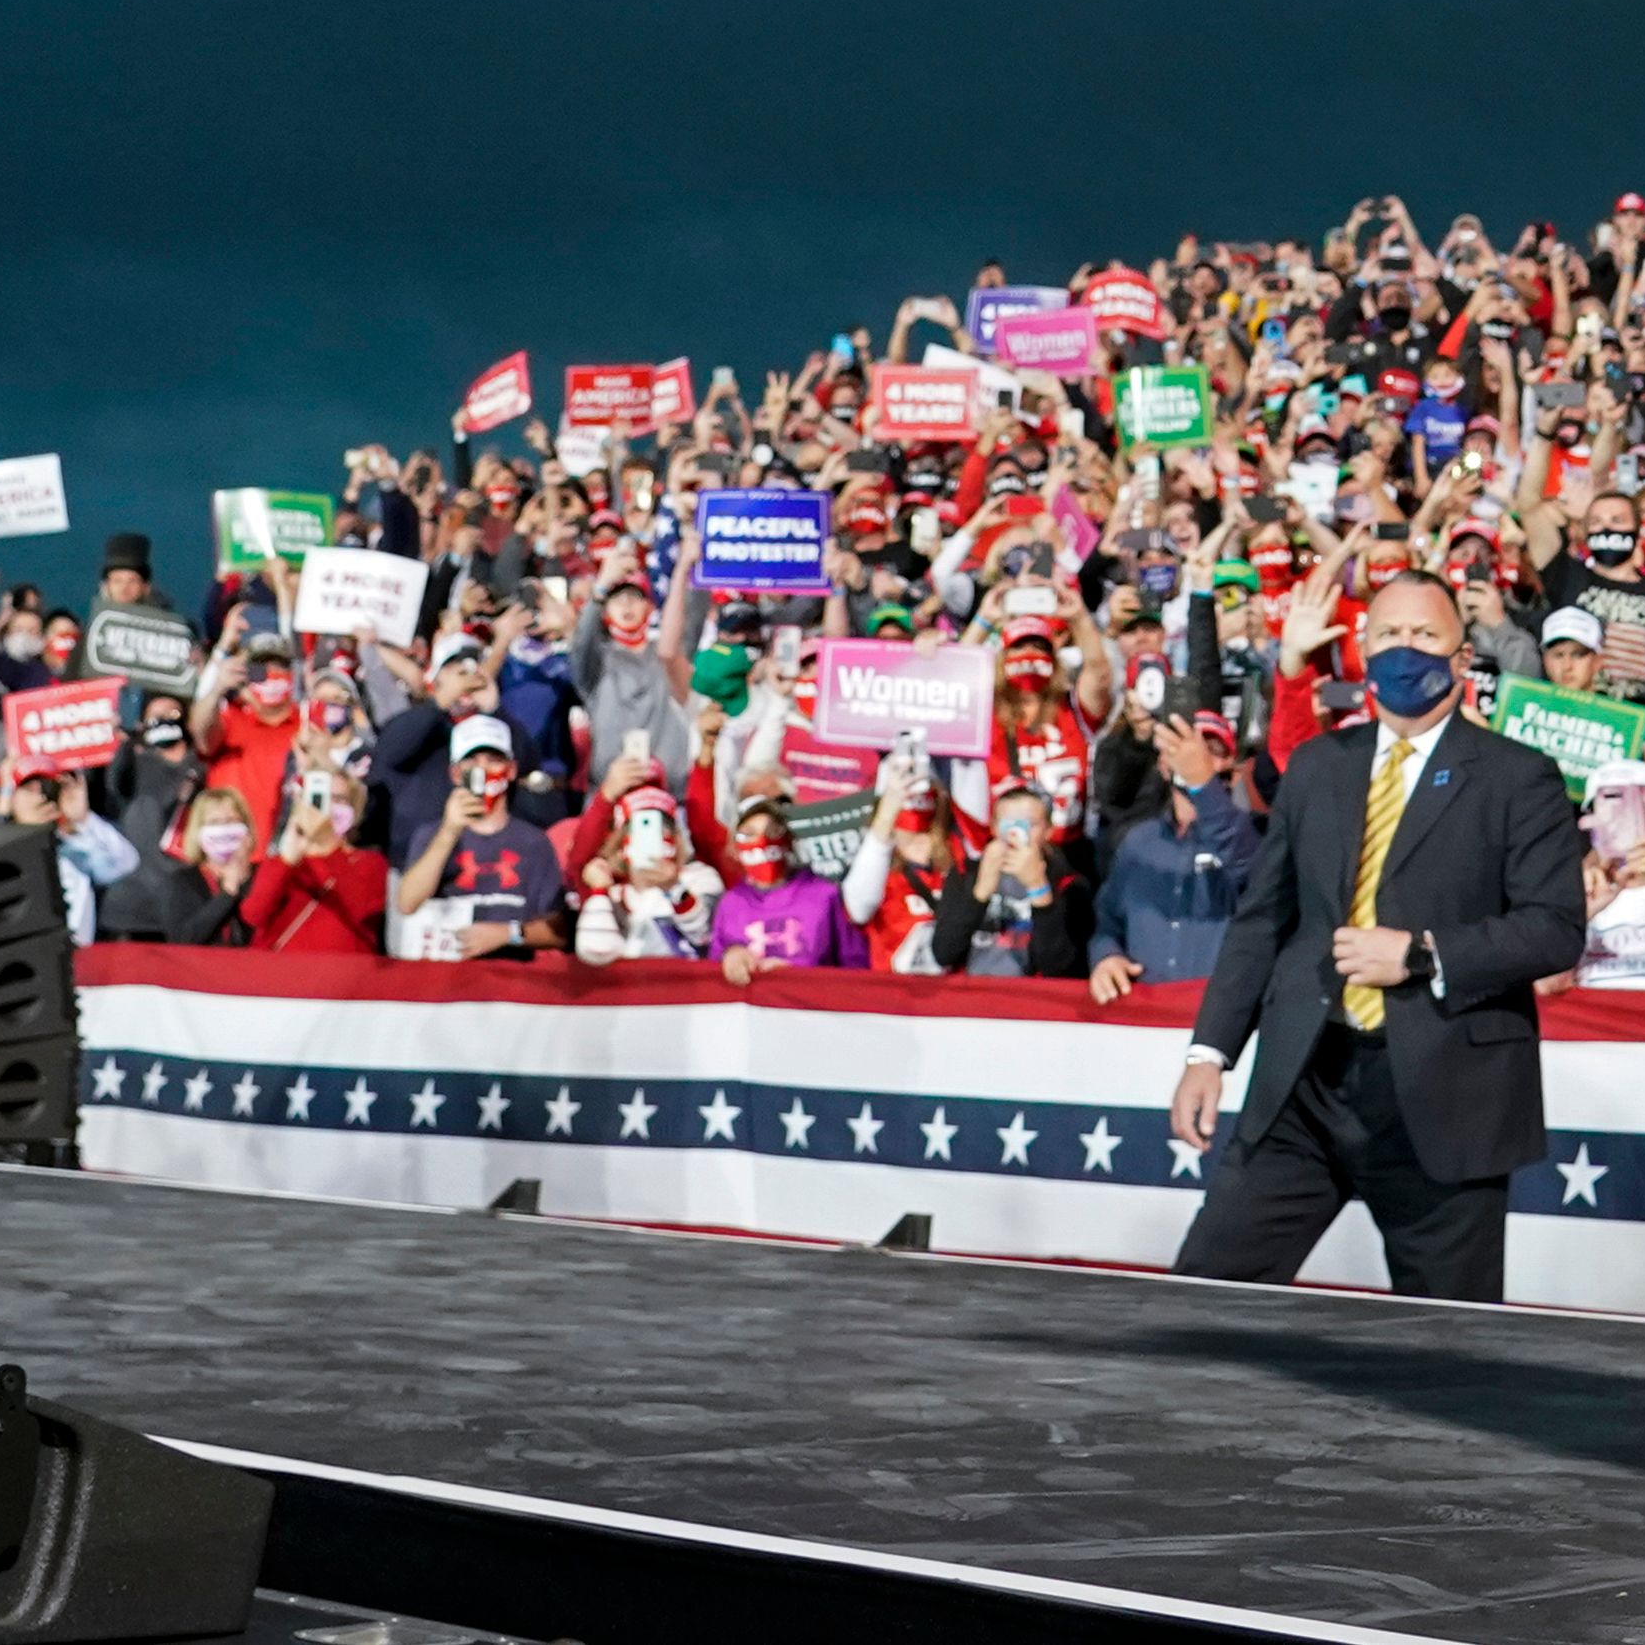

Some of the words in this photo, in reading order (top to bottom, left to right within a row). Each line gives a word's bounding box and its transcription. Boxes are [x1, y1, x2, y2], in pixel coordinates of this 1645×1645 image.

[1006, 330, 1088, 353] Women
[571, 387, 652, 406] AMERICA
[885, 383, 902, 401] 4
[903, 382, 968, 402] MORE
[886, 404, 965, 423] YEARS!
[706, 515, 821, 539] PEACEFUL
[706, 541, 821, 563] PROTESTER
[343, 571, 404, 596] MORE
[837, 664, 970, 709] Women
[22, 710, 40, 733] 4
[41, 698, 113, 728] MORE
[1522, 700, 1613, 744] FARMERS
[25, 722, 115, 756] YEARS!
[1503, 714, 1625, 765] RANCHERS
